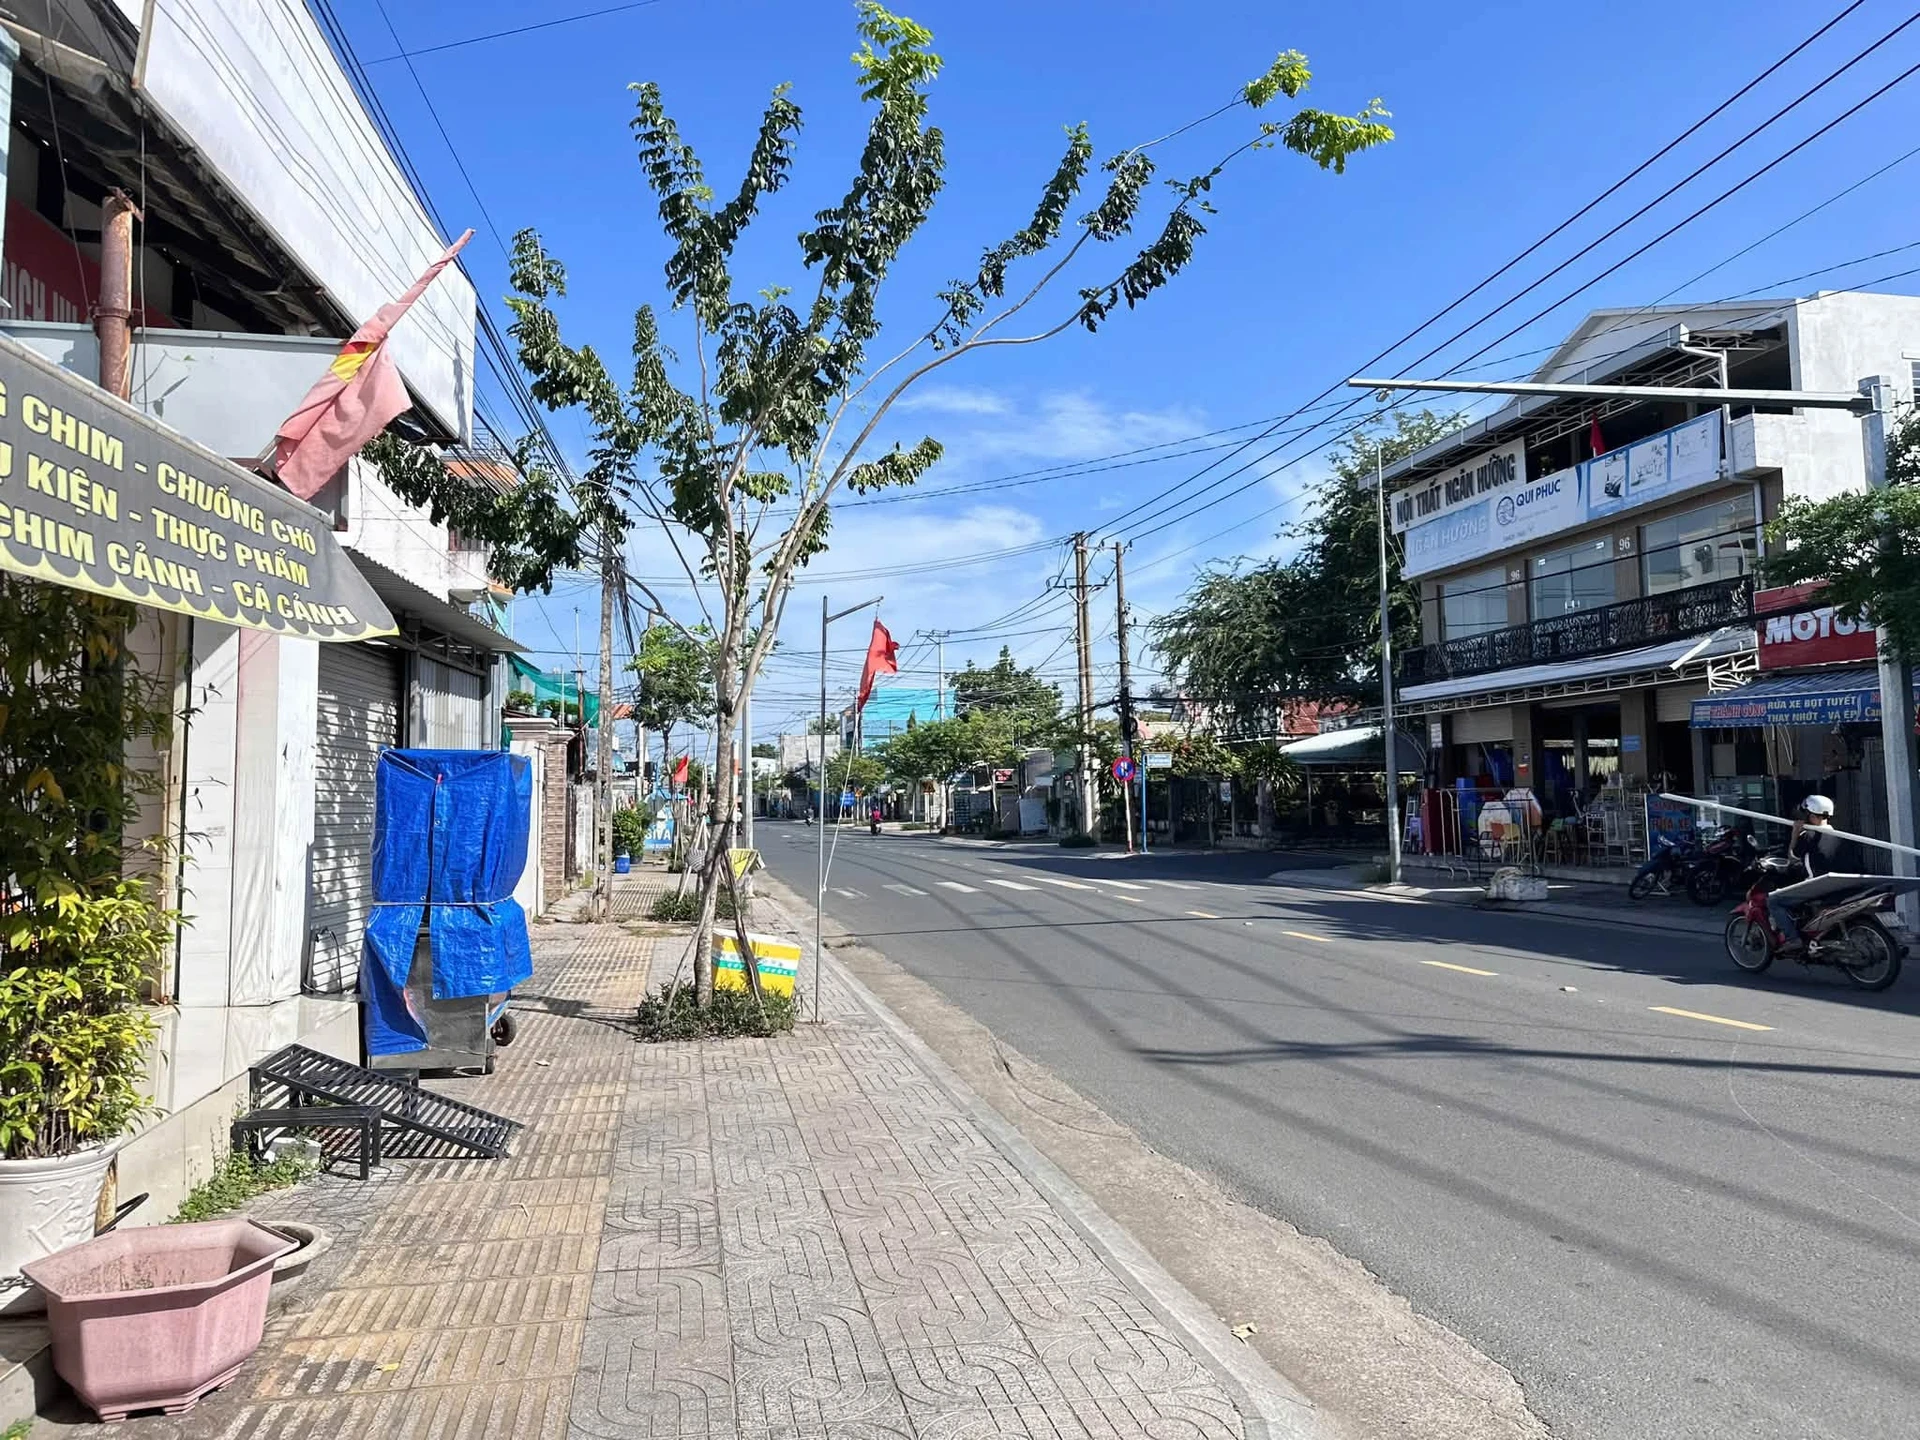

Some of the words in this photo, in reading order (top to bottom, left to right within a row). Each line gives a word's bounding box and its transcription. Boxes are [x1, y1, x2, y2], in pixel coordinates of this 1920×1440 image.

[22, 394, 124, 472] CHIM
[157, 462, 265, 536] CHUỒNG
[270, 518, 317, 556] CHÓ
[1396, 492, 1413, 528] NỘI
[1416, 477, 1441, 517] THẤT
[1445, 468, 1475, 507] NGÂN
[1516, 489, 1534, 507] QUI
[27, 453, 118, 522] KIỆN
[151, 507, 228, 562] THỰC
[234, 541, 311, 589] PHẨM
[1618, 537, 1631, 551] 96
[106, 541, 205, 597] CẢNH
[232, 580, 272, 614] CÁ
[276, 591, 360, 627] CẢNH
[1510, 569, 1520, 581] 96
[1788, 699, 1801, 709] XE
